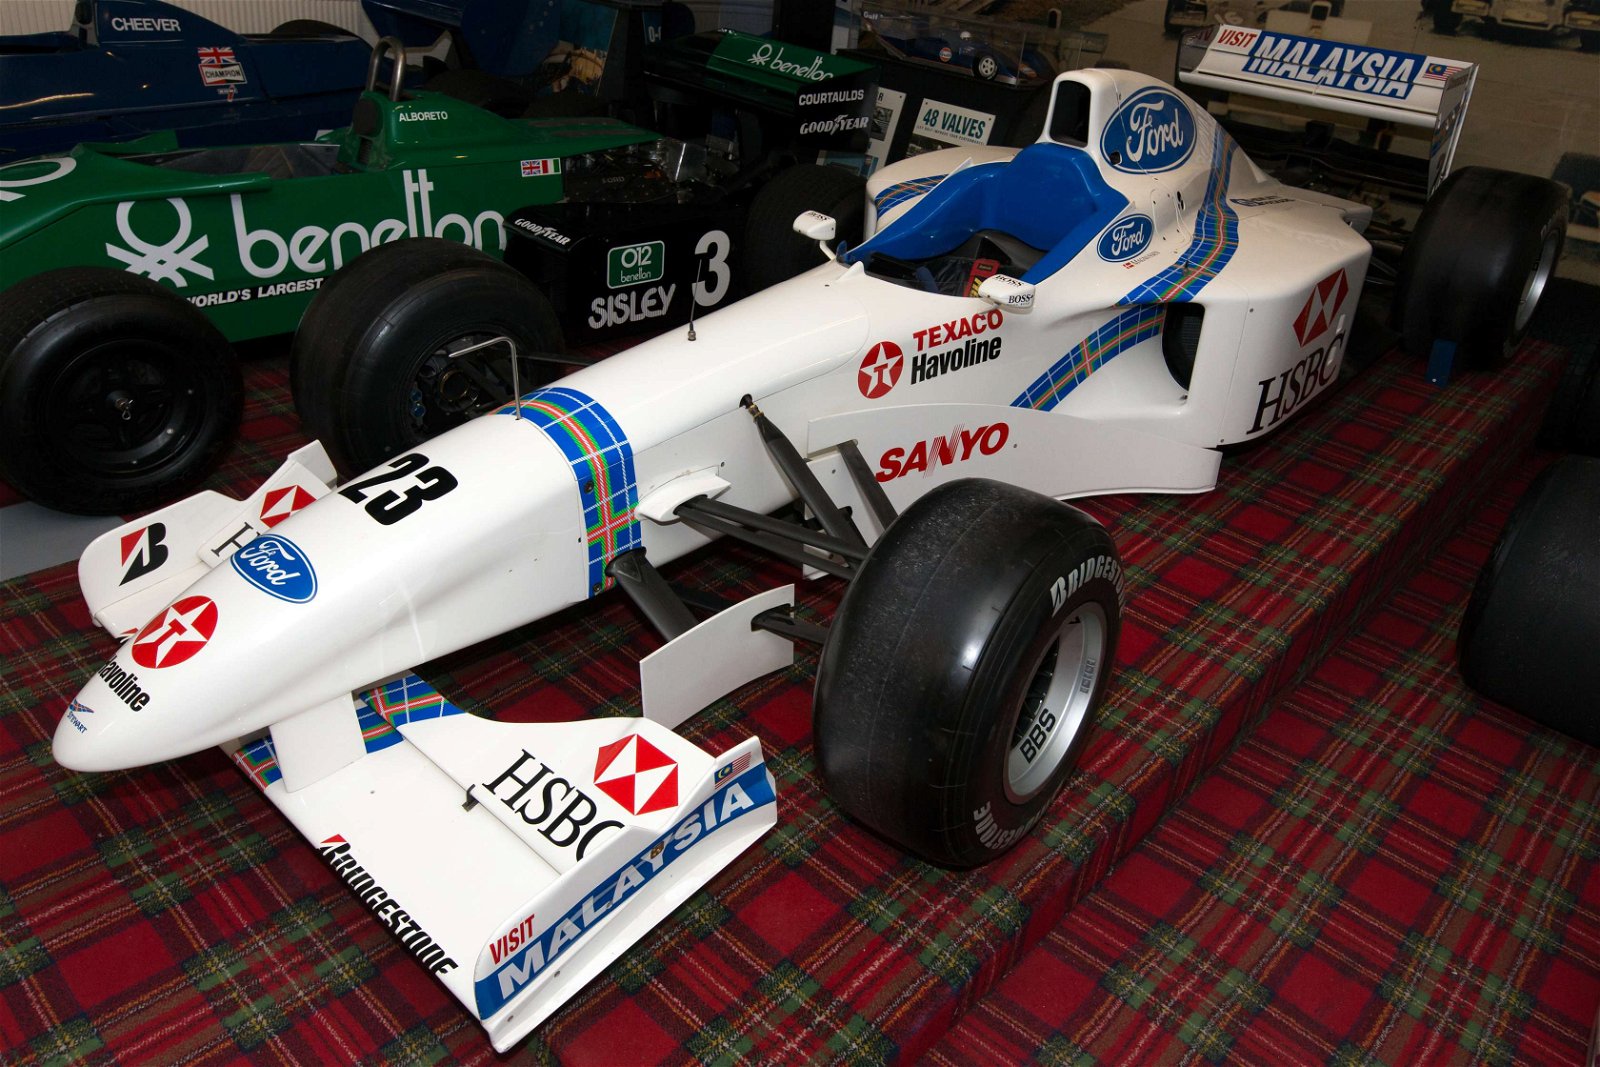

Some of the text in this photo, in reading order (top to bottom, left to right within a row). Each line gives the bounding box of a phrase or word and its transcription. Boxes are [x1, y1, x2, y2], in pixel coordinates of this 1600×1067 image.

[111, 17, 181, 32] CHEEVER
[1218, 29, 1257, 48] VISIT
[205, 70, 241, 78] CHAMPION
[1248, 36, 1416, 98] MALAYSIA
[399, 111, 448, 122] ALBORETO
[799, 90, 864, 106] COURTAULDS
[923, 107, 986, 139] 48 VALVES
[1126, 99, 1184, 162] Ford
[1111, 222, 1144, 258] Ford
[257, 278, 324, 298] LARGEST
[620, 266, 652, 283] benetton
[692, 230, 731, 306] 3
[995, 275, 1025, 287] BOSS
[588, 283, 677, 330] SISLEY
[1008, 294, 1034, 304] BOSS
[912, 310, 1005, 352] TEXACO
[910, 335, 1002, 385] Havoline
[1245, 331, 1345, 435] HSBC
[875, 421, 1010, 483] SANYO
[337, 452, 458, 526] 23
[239, 539, 300, 587] Ford
[67, 710, 88, 734] STEWART
[1019, 708, 1056, 764] BBS
[482, 749, 625, 862] HSBC
[499, 782, 754, 1001] MALAYSIA
[489, 914, 536, 966] VISIT
